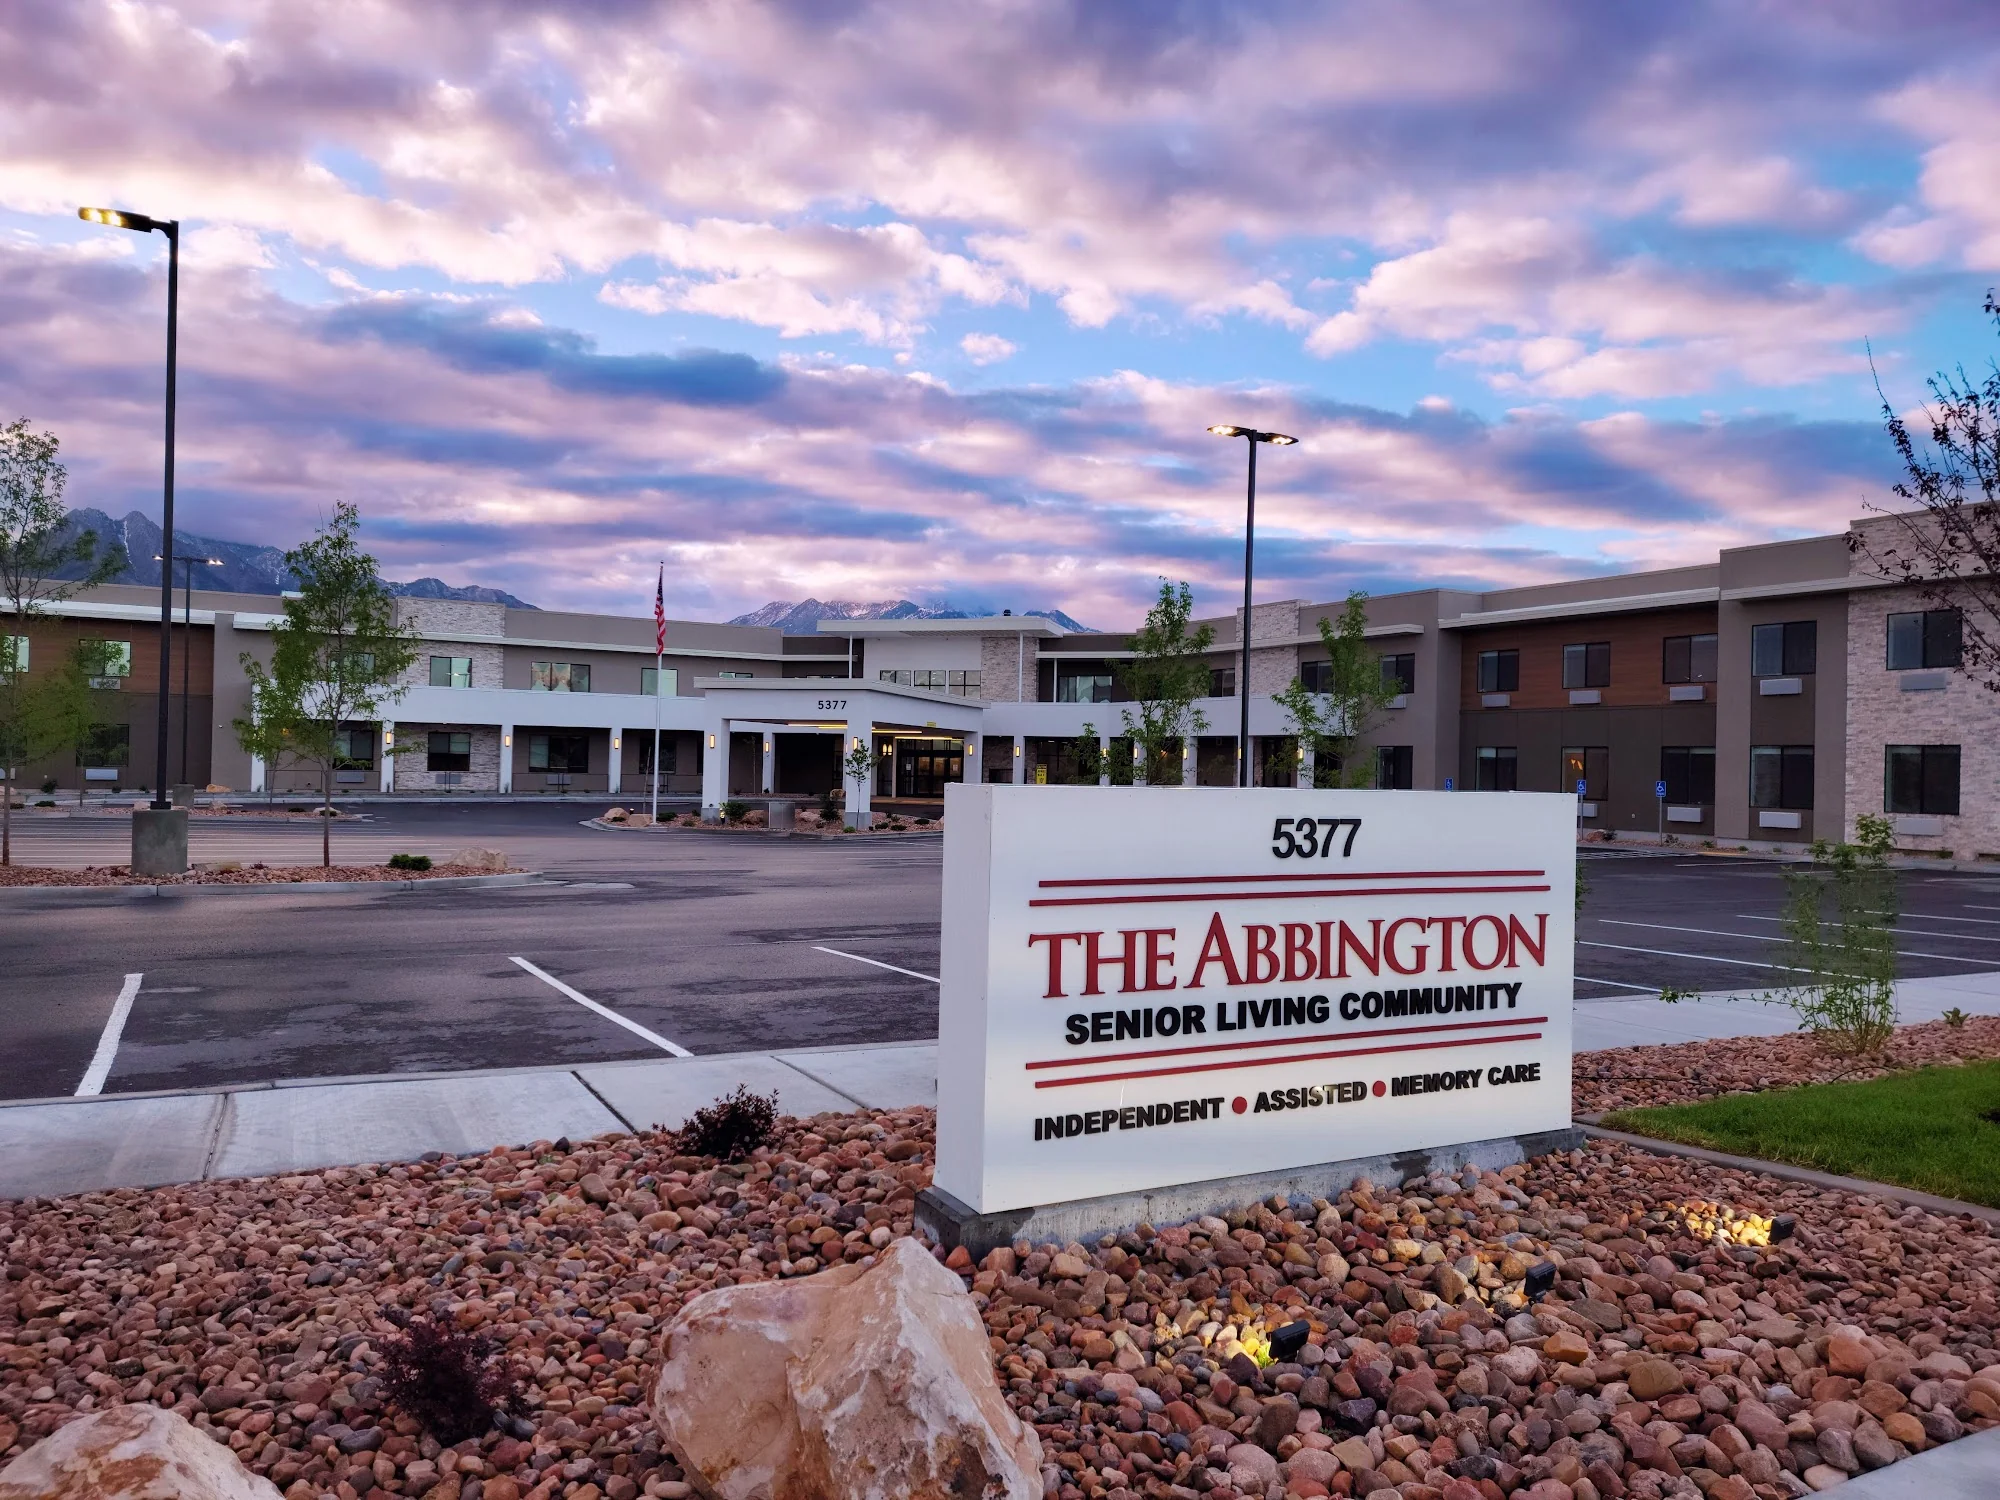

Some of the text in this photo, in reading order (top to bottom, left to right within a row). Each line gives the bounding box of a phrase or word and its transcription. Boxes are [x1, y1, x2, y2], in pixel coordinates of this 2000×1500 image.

[817, 700, 847, 710] 5377
[1271, 817, 1362, 859] 5377
[1028, 911, 1550, 999] THE ABBINGTON
[1065, 982, 1523, 1046] SENIOR LIVING COMMUNITY
[1034, 1062, 1542, 1142] INDEPENDENT ASSISTED MEMORY CARE
